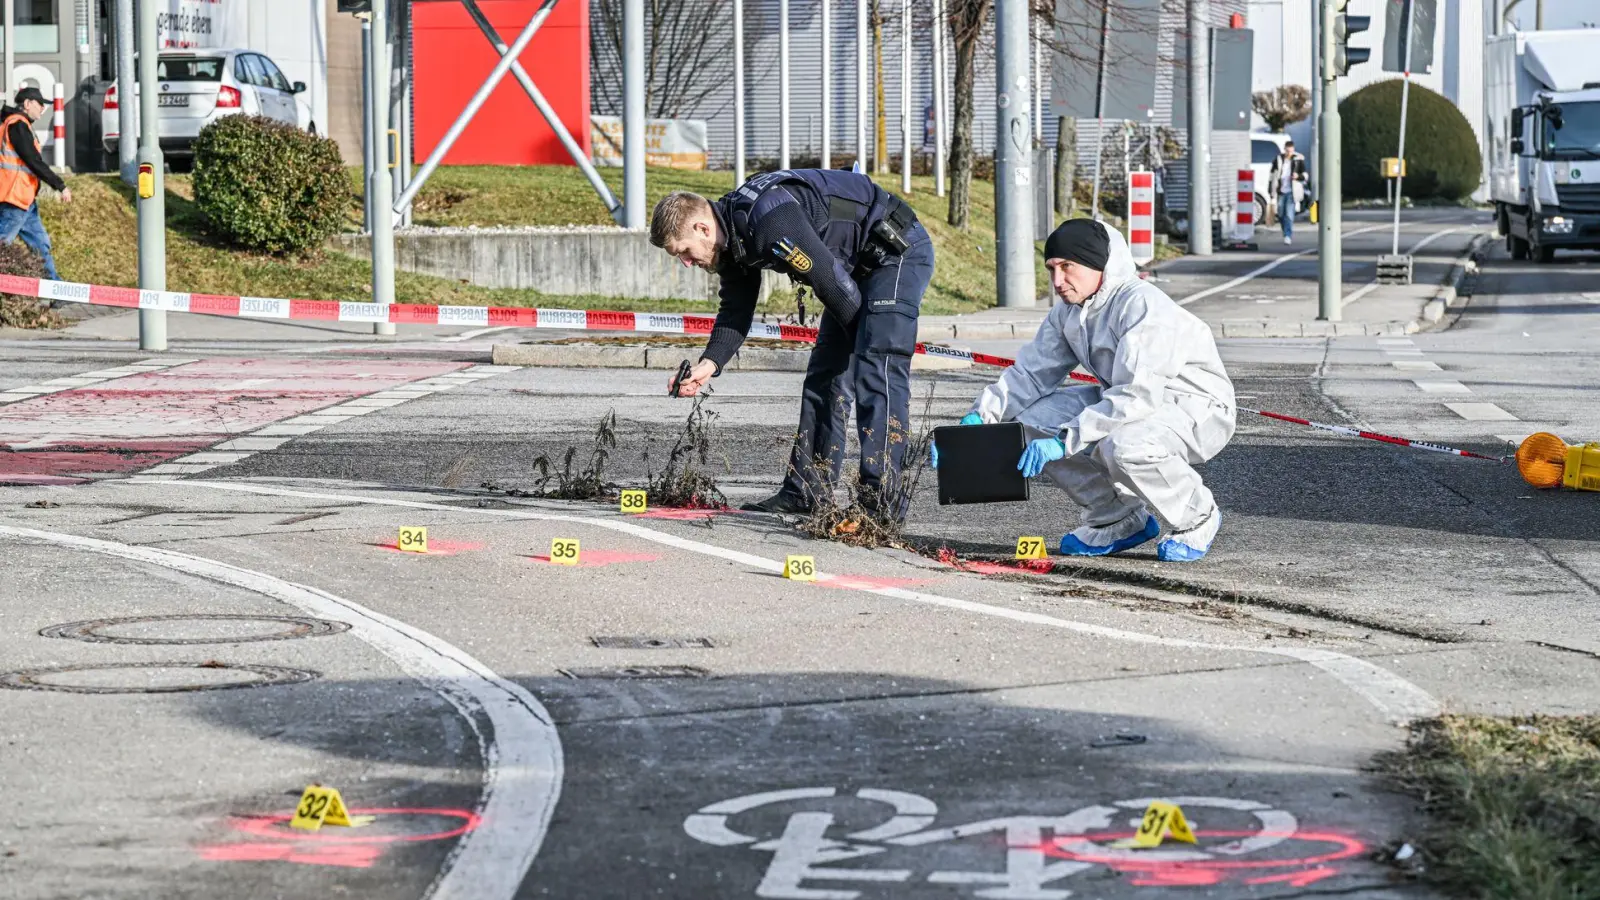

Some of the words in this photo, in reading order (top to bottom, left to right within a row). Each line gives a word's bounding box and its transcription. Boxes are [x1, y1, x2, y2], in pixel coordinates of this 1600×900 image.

[157, 7, 189, 36] gerade
[192, 9, 211, 34] eben
[622, 494, 644, 508] 38
[401, 530, 424, 546] 34
[552, 542, 576, 558] 35
[1018, 540, 1040, 556] 37
[790, 560, 813, 576] 36
[298, 793, 328, 819] 32
[1141, 808, 1170, 838] 31
